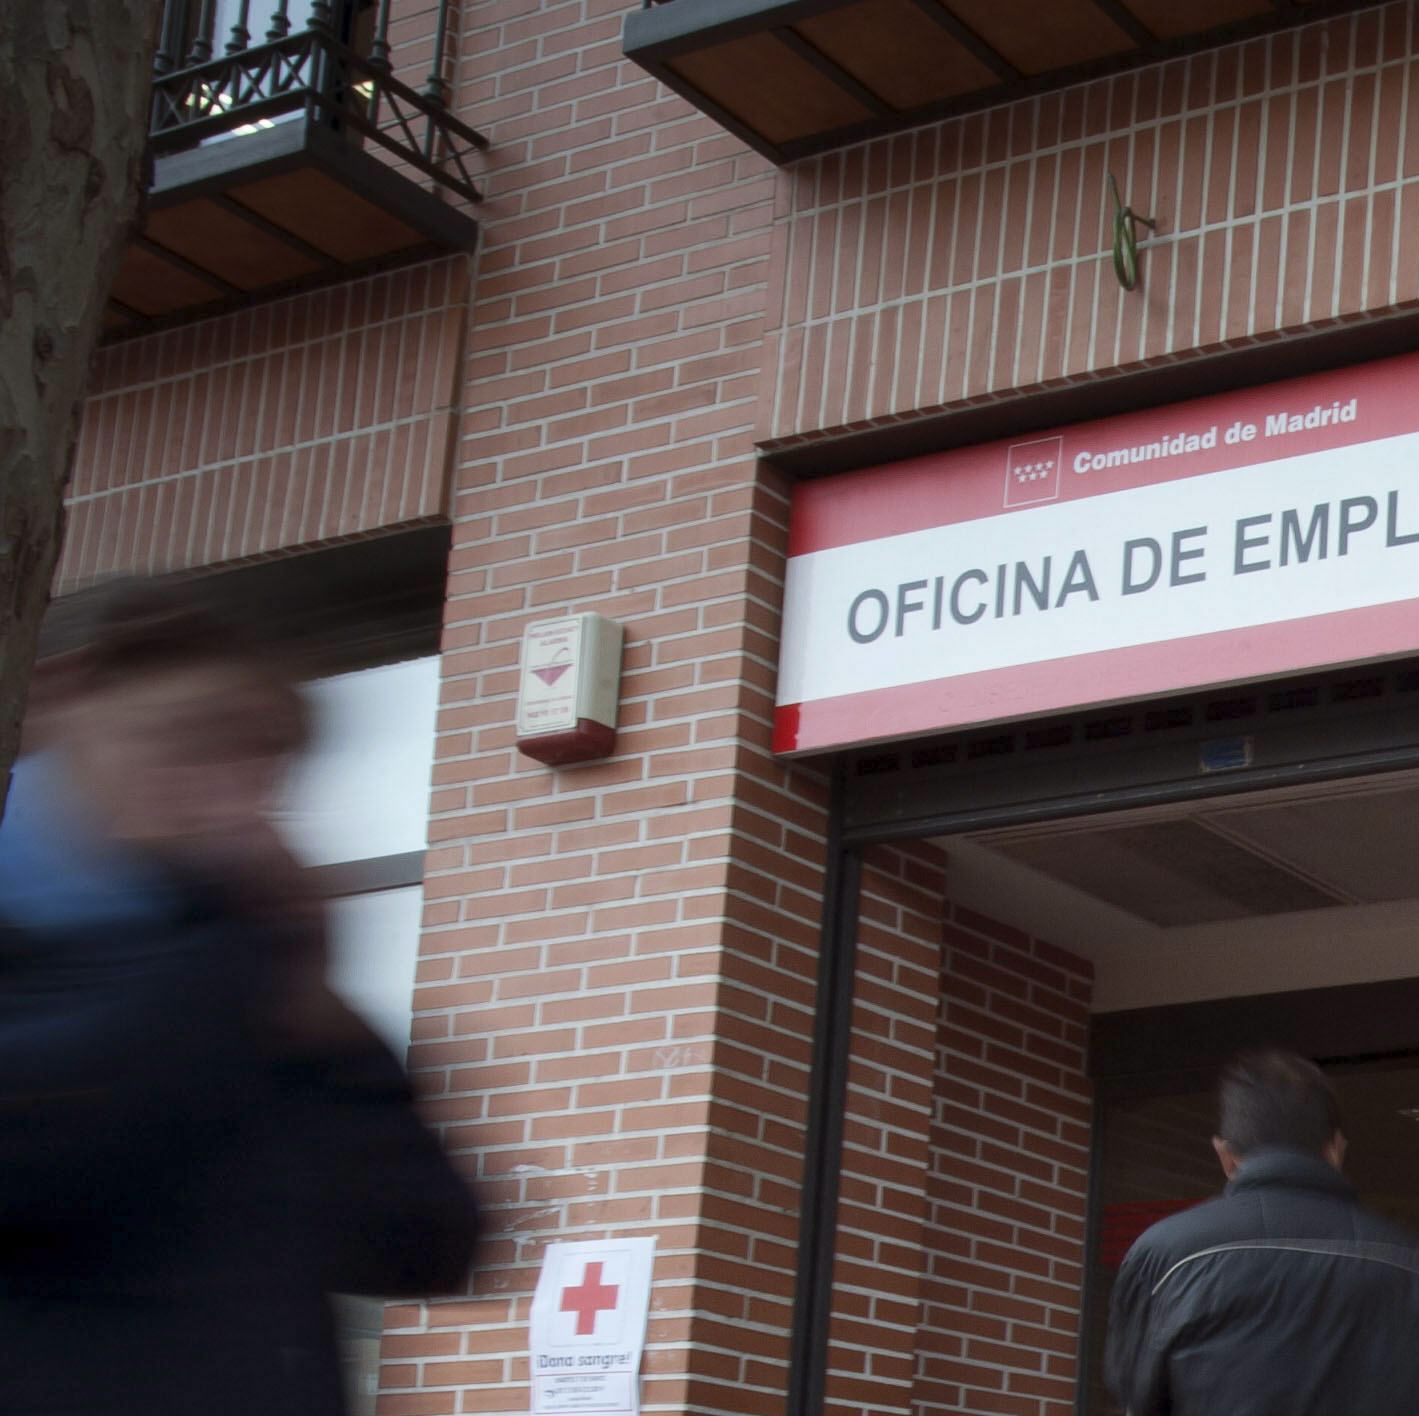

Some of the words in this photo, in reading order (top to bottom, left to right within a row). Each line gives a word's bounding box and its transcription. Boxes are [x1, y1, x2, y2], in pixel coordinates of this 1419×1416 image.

[1073, 427, 1217, 474] Comunidad
[1224, 422, 1257, 445] de
[1265, 399, 1358, 437] Madrid
[846, 549, 1100, 645] OFICINA
[1121, 526, 1208, 596] DE
